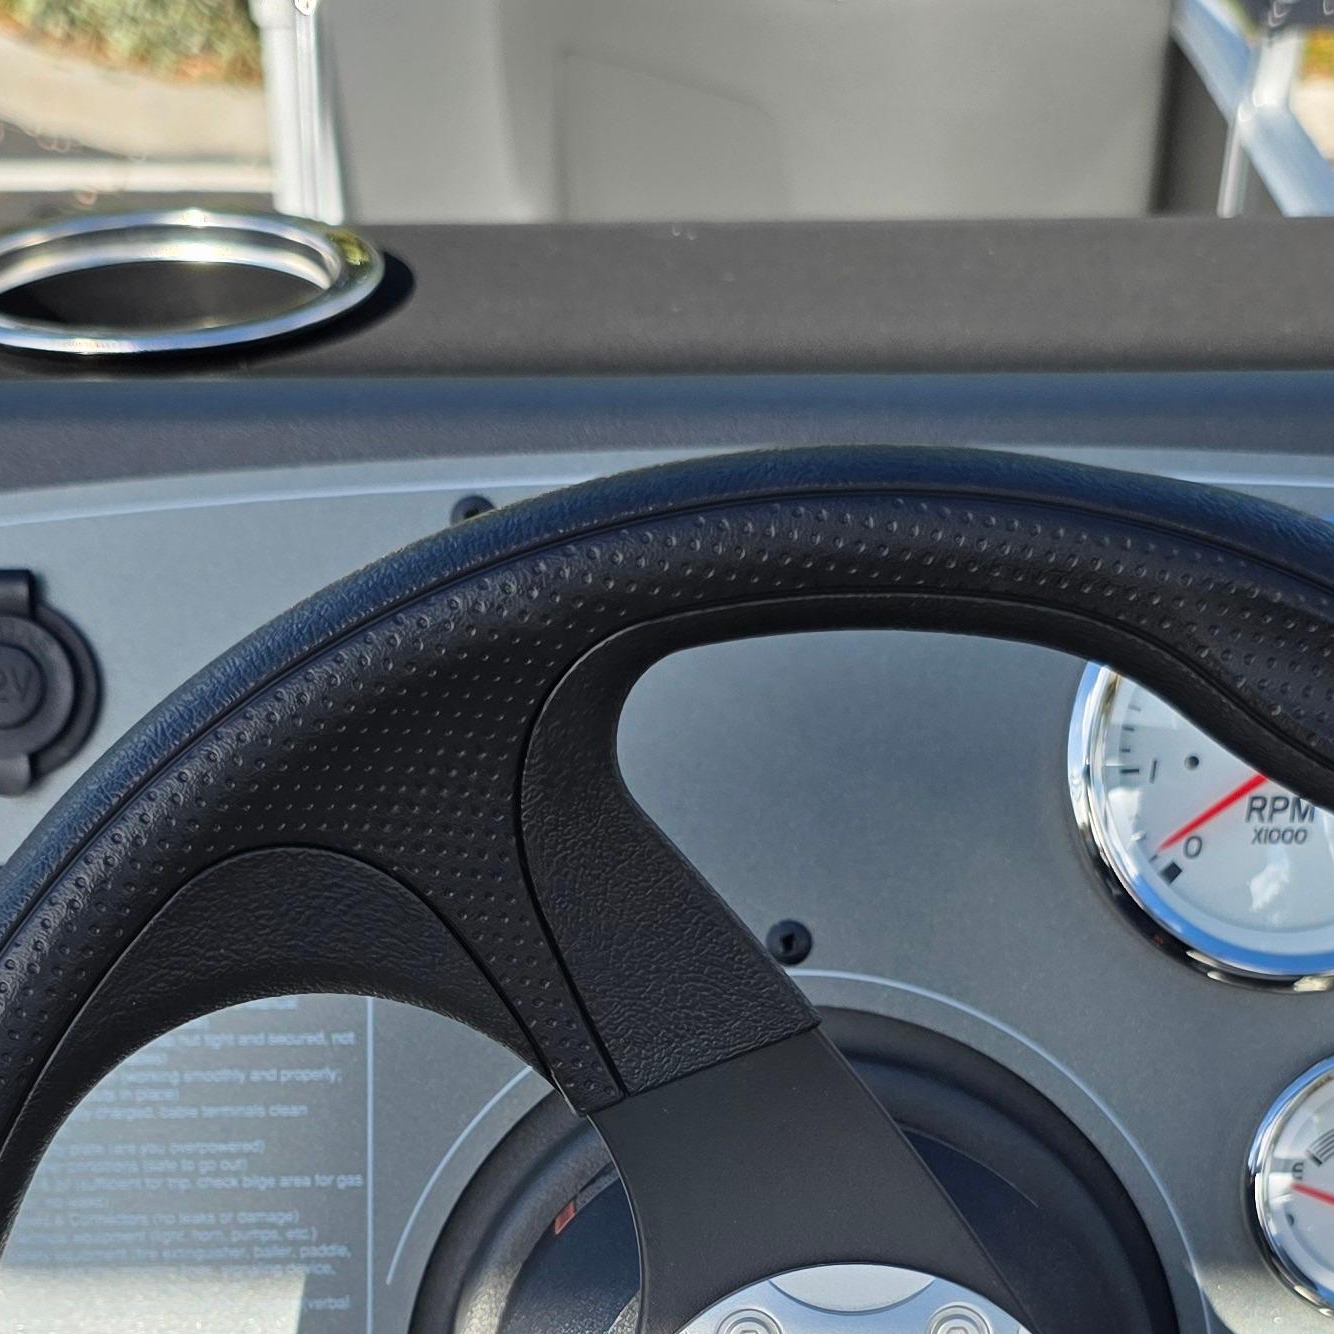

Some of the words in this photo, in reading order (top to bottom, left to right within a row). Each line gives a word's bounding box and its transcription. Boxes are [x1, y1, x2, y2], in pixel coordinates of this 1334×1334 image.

[1244, 795, 1317, 824] RPM
[1251, 827, 1308, 845] X1000
[249, 1068, 277, 1082] and
[337, 1173, 362, 1190] gas
